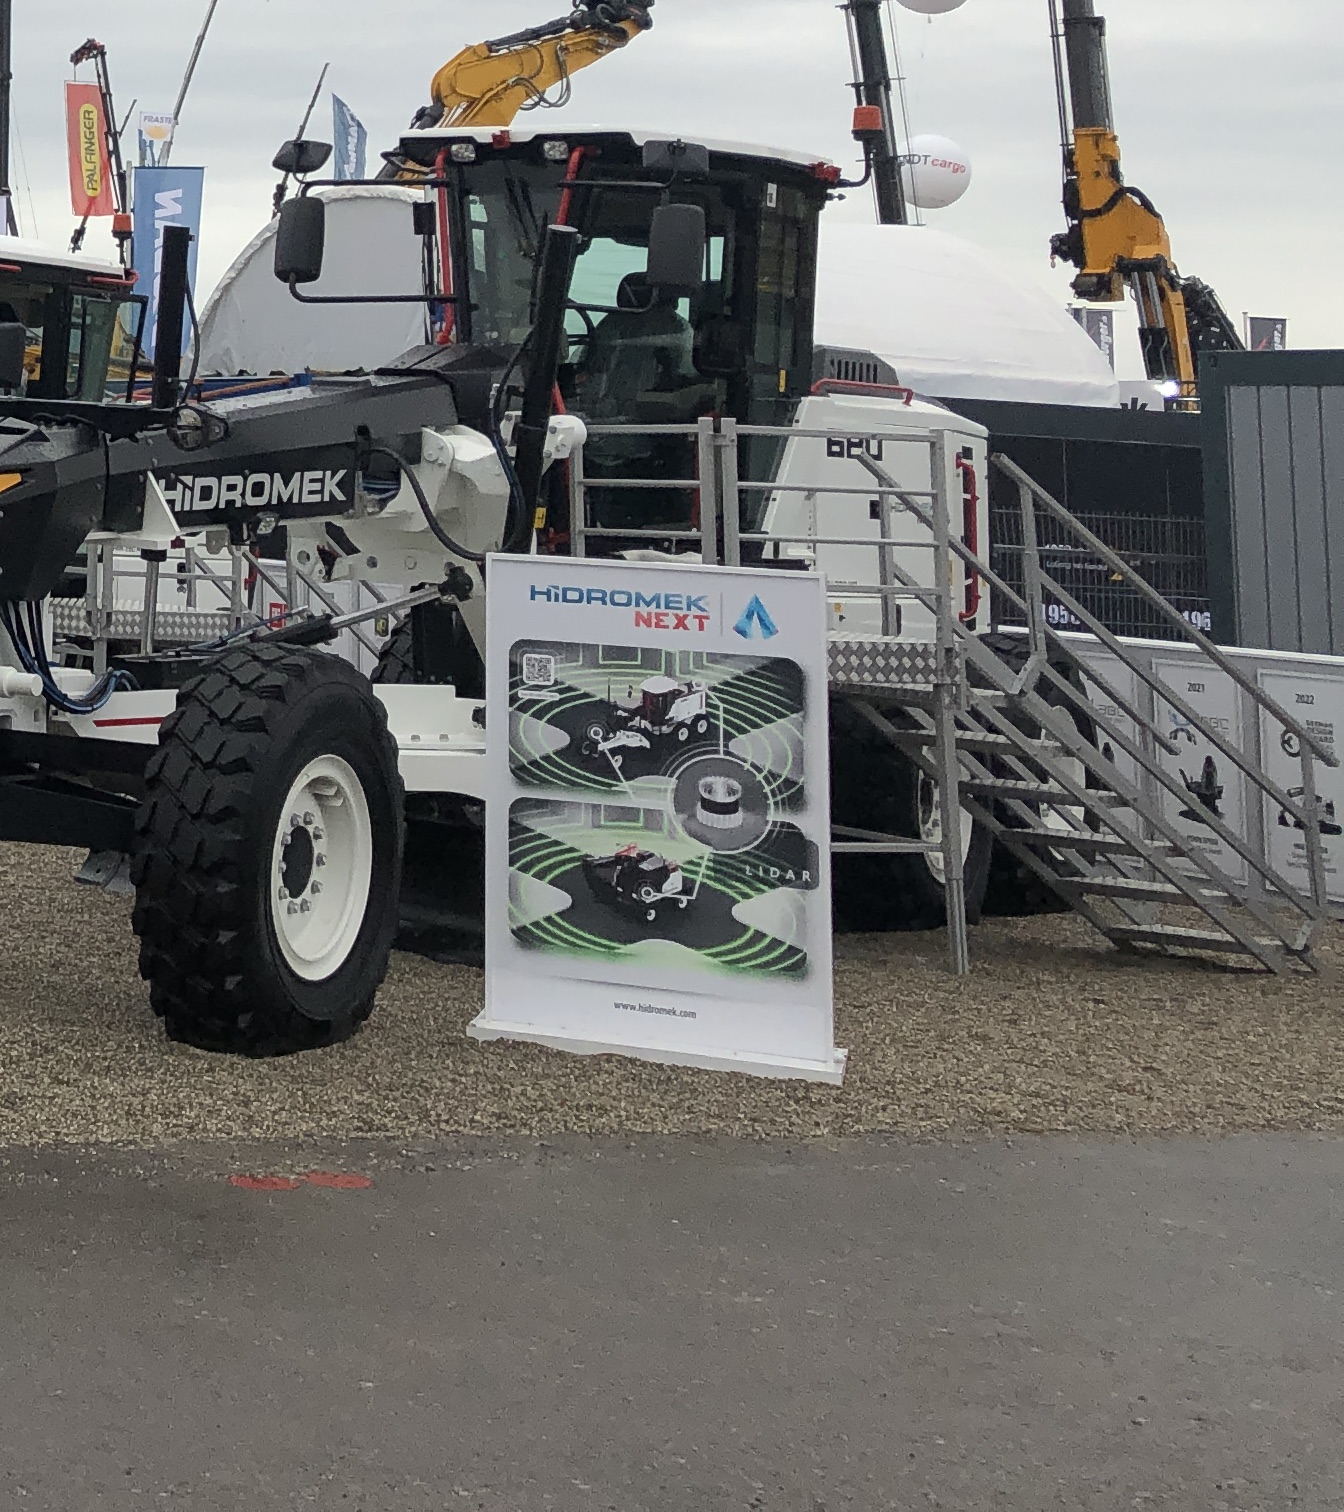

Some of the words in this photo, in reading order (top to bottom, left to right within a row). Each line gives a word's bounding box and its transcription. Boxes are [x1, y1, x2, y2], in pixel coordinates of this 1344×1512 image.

[86, 108, 99, 192] PALFINGER
[634, 610, 711, 632] NEXT
[745, 864, 812, 882] LIDAR
